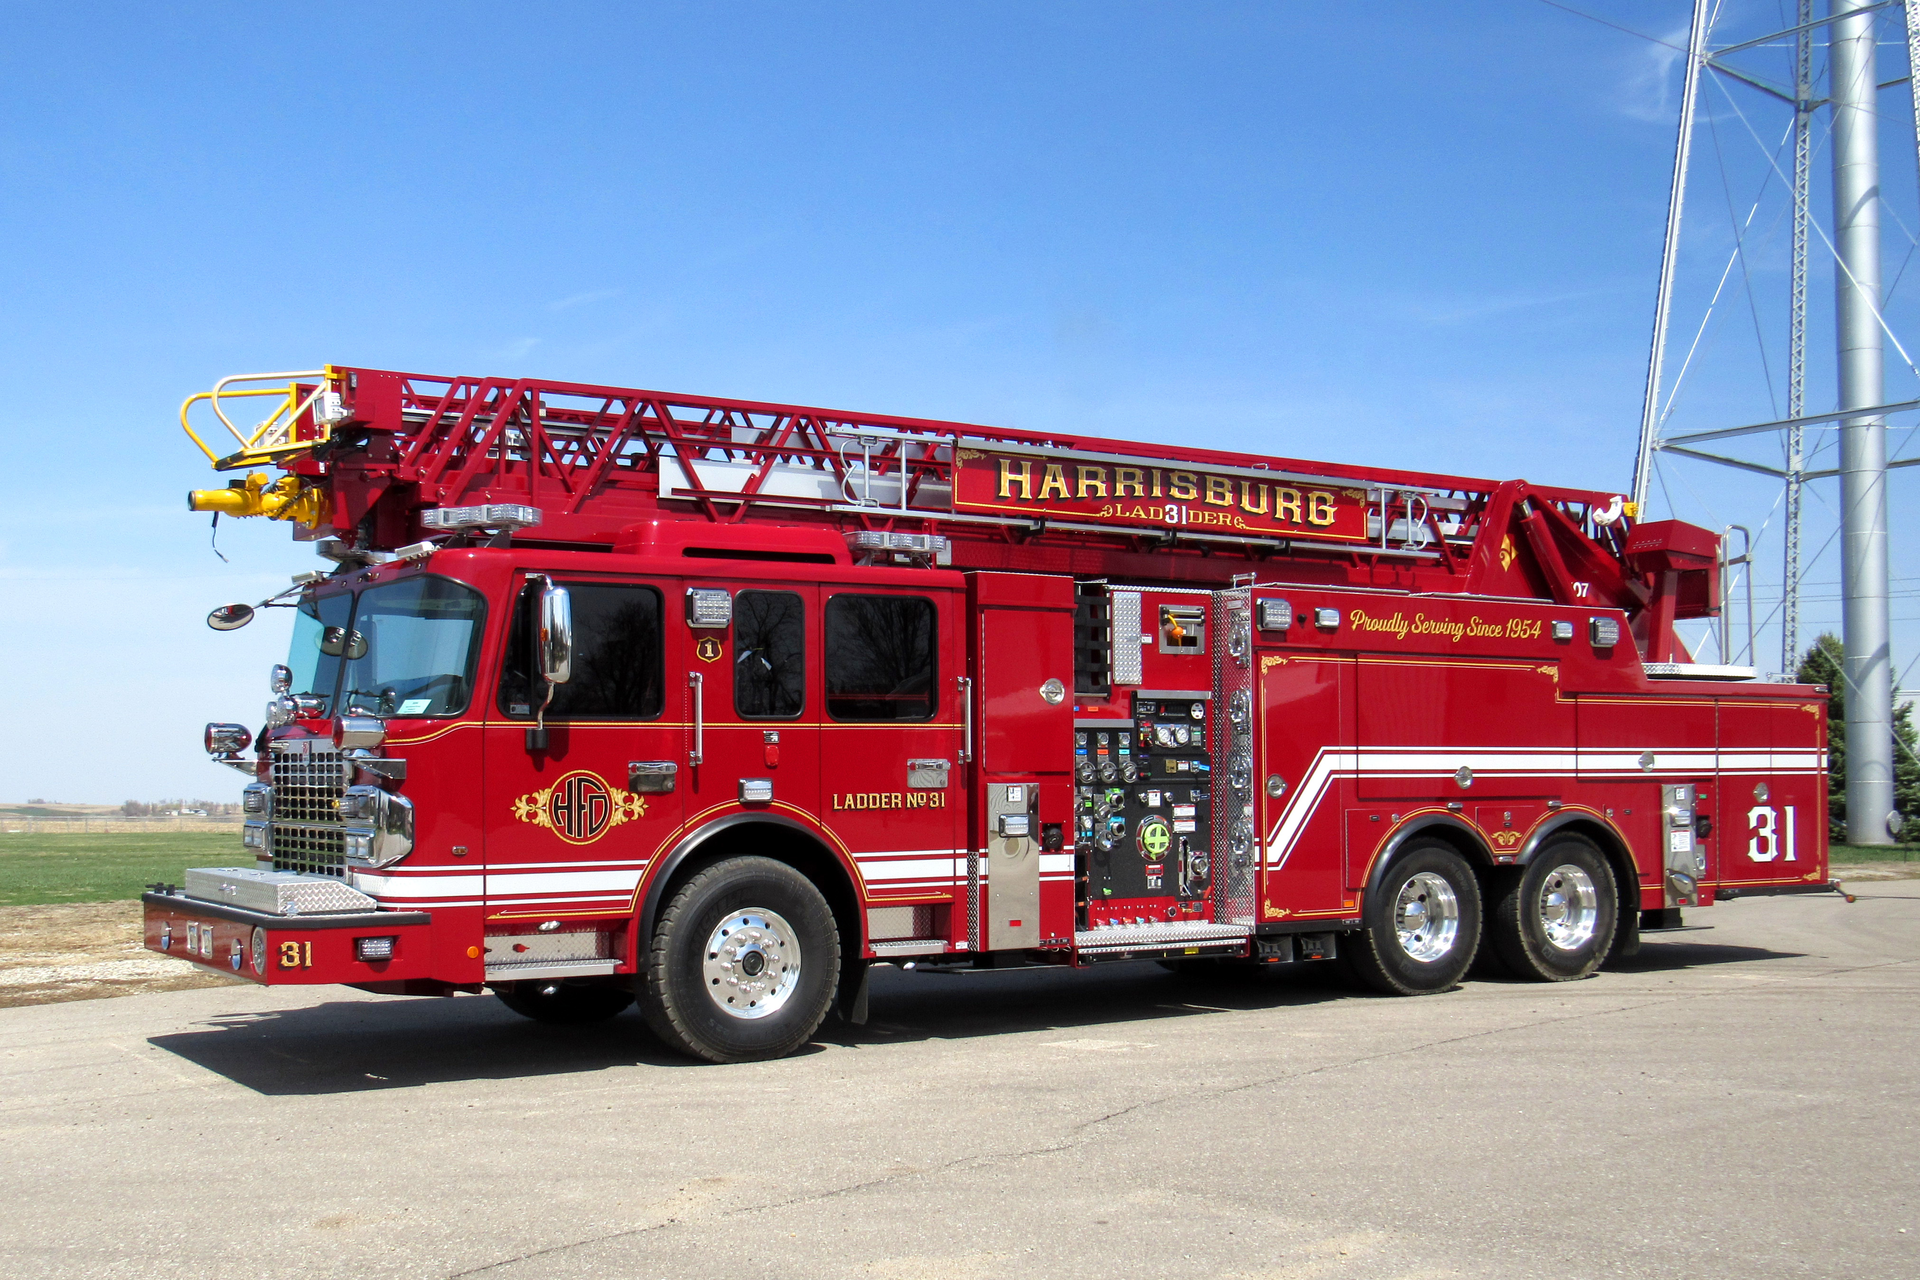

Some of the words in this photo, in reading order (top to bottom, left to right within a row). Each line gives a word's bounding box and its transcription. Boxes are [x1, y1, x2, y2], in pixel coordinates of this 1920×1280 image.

[997, 459, 1338, 527] HARRISBURG
[1350, 609, 1409, 640] Proudly
[1411, 612, 1465, 642] Serving
[1466, 615, 1503, 637] Since
[1505, 618, 1542, 639] 1954
[705, 641, 715, 657] 1
[552, 776, 609, 838] HFD
[833, 792, 902, 810] LADDER
[929, 792, 945, 808] 31
[1747, 806, 1796, 862] 31
[280, 941, 313, 967] 31
